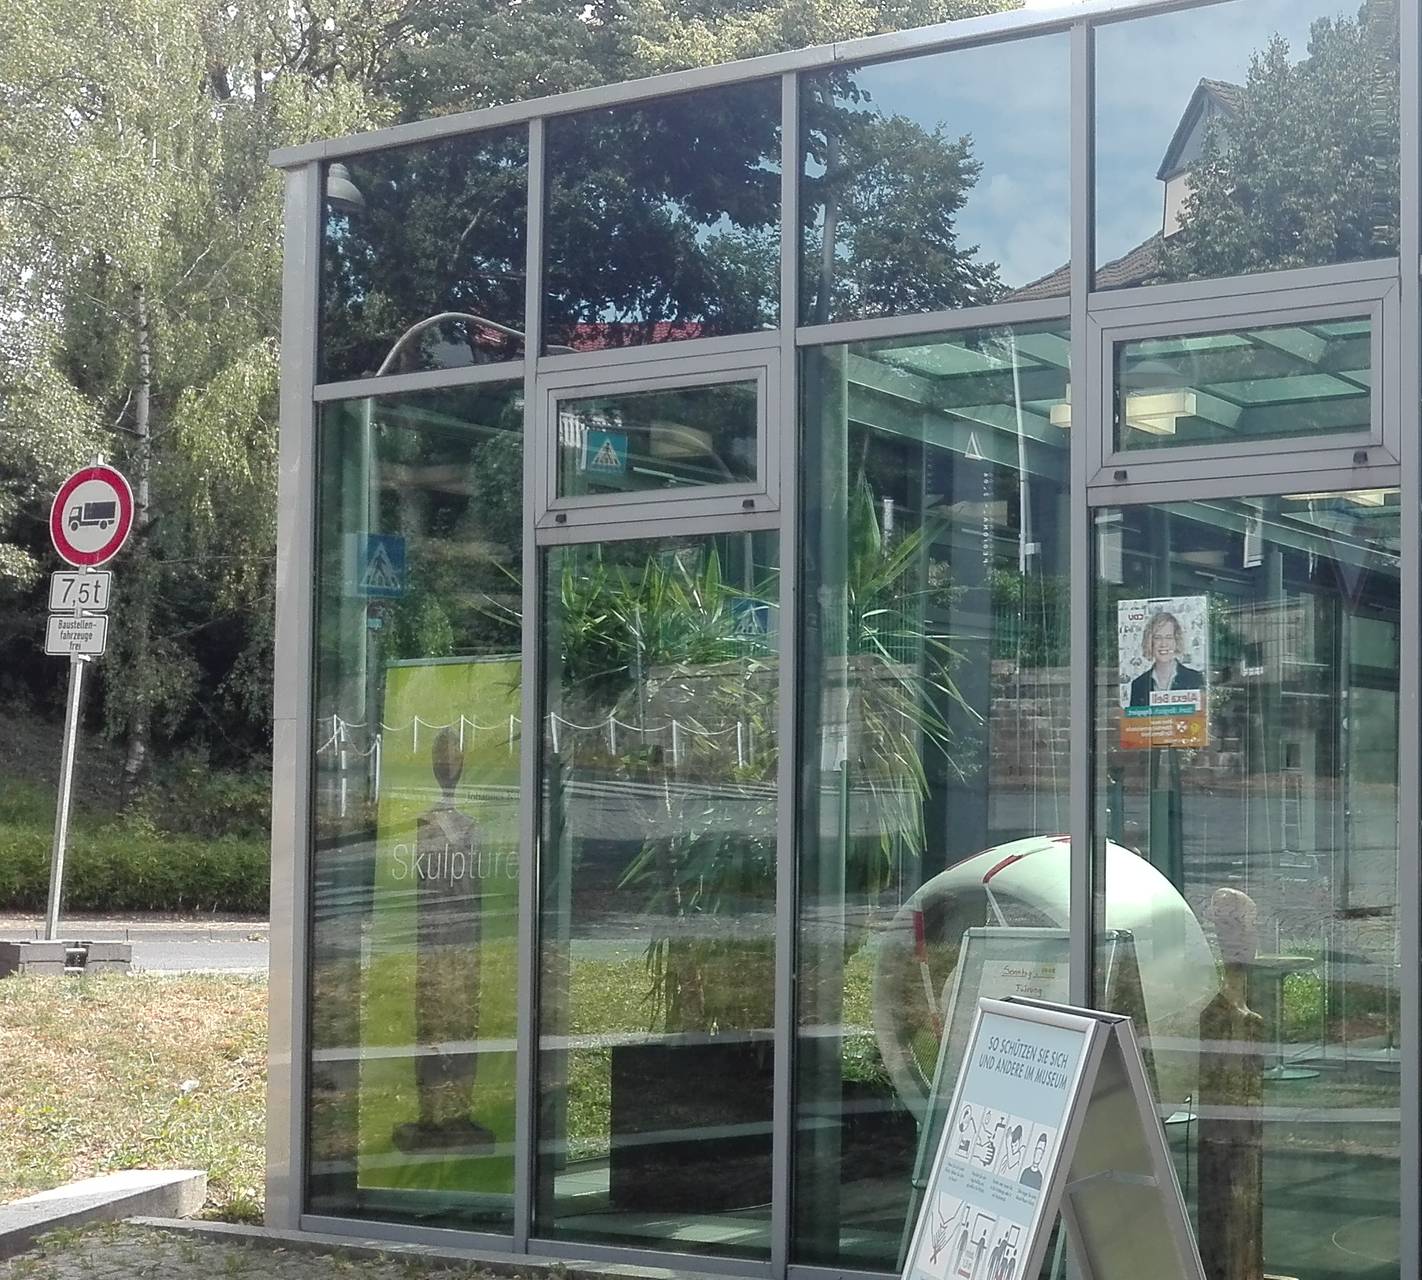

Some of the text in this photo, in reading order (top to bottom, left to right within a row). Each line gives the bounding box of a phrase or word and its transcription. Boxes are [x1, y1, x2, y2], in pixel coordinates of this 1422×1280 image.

[58, 619, 97, 630] Baustellen-
[60, 630, 93, 643] fahrzeuge
[69, 641, 82, 651] frei
[988, 1036, 1069, 1069] SO SCHÜTZEN SIE SICH
[979, 1054, 1068, 1090] UND ANDERE IM MUSEUM
